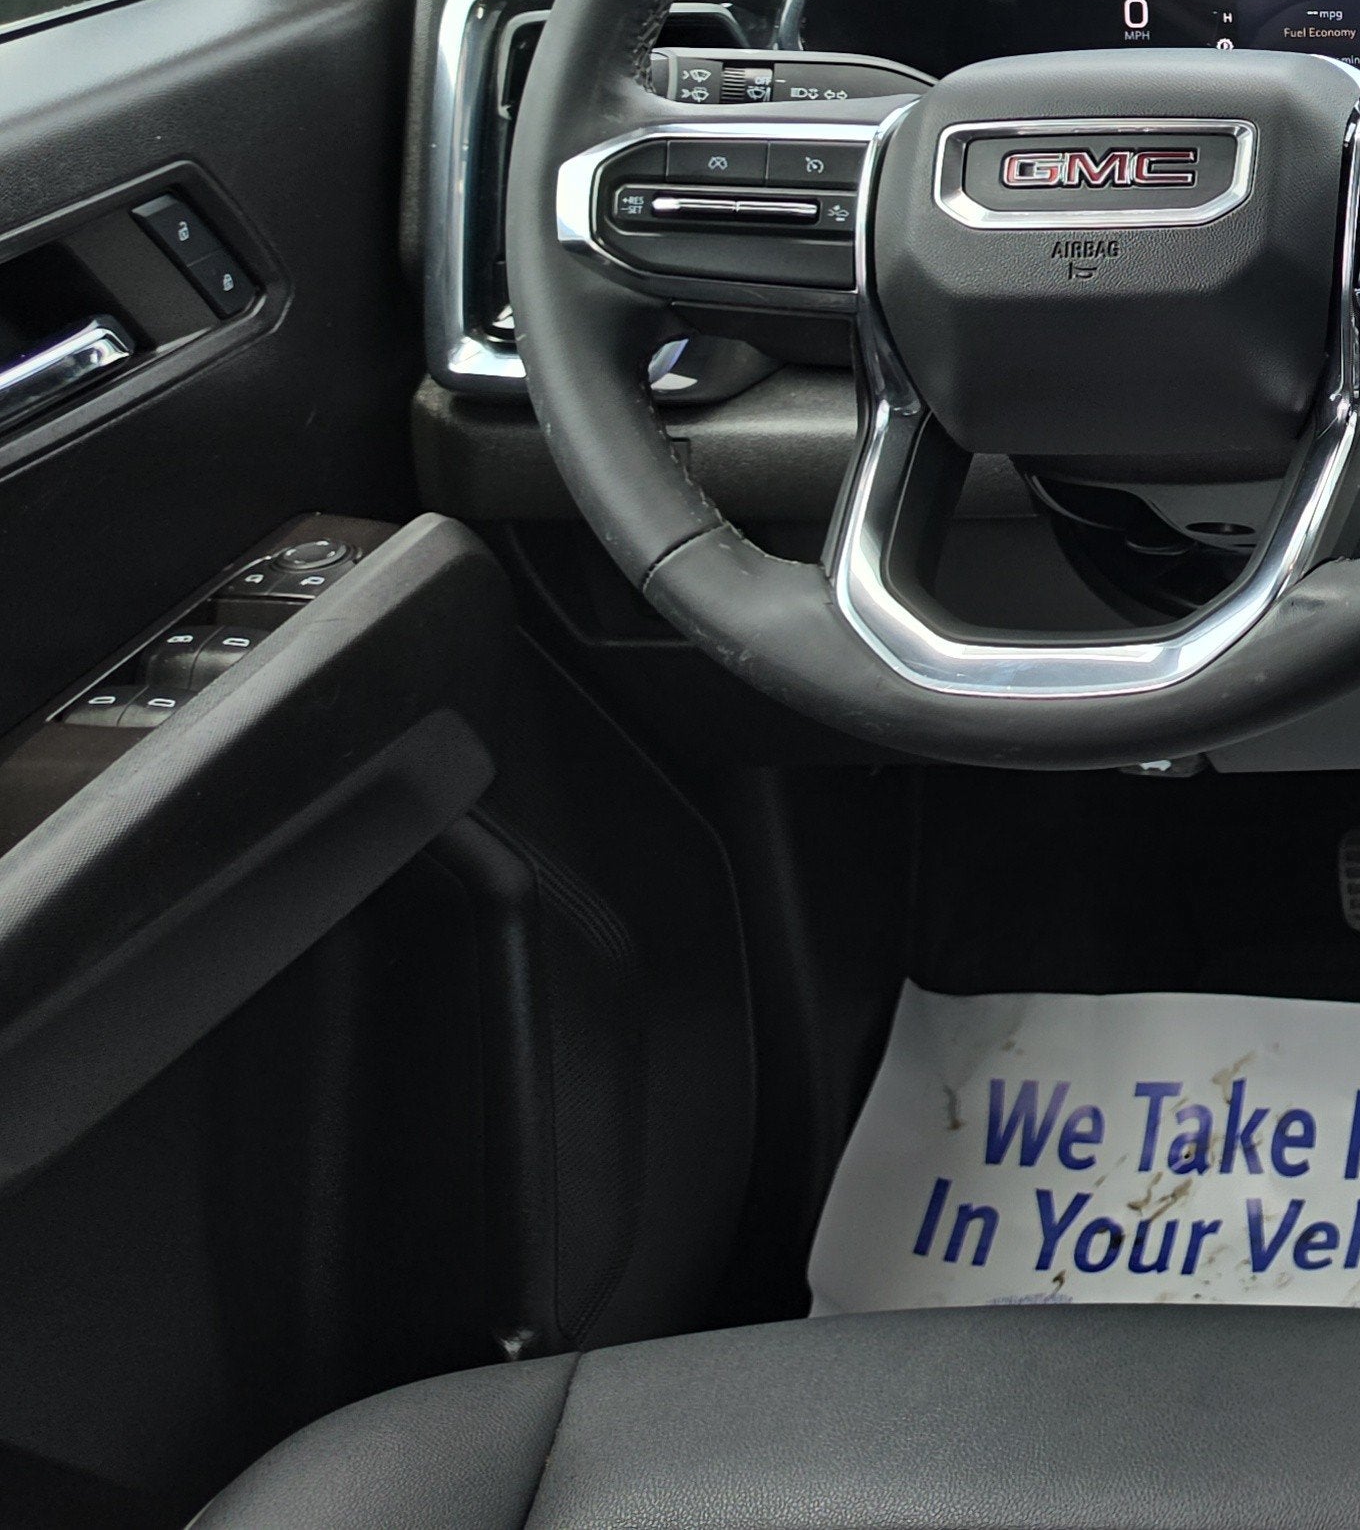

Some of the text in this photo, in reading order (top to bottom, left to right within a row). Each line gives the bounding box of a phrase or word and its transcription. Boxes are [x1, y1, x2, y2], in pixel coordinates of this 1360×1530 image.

[1222, 12, 1233, 23] H
[1124, 30, 1150, 41] MPH
[1283, 27, 1357, 40] Fuel Economy
[1002, 146, 1199, 190] GMC
[1051, 239, 1121, 260] AIRBAG
[982, 1077, 1106, 1172] We
[1132, 1077, 1318, 1180] Take
[911, 1177, 1001, 1268] In
[1033, 1187, 1222, 1276] Your
